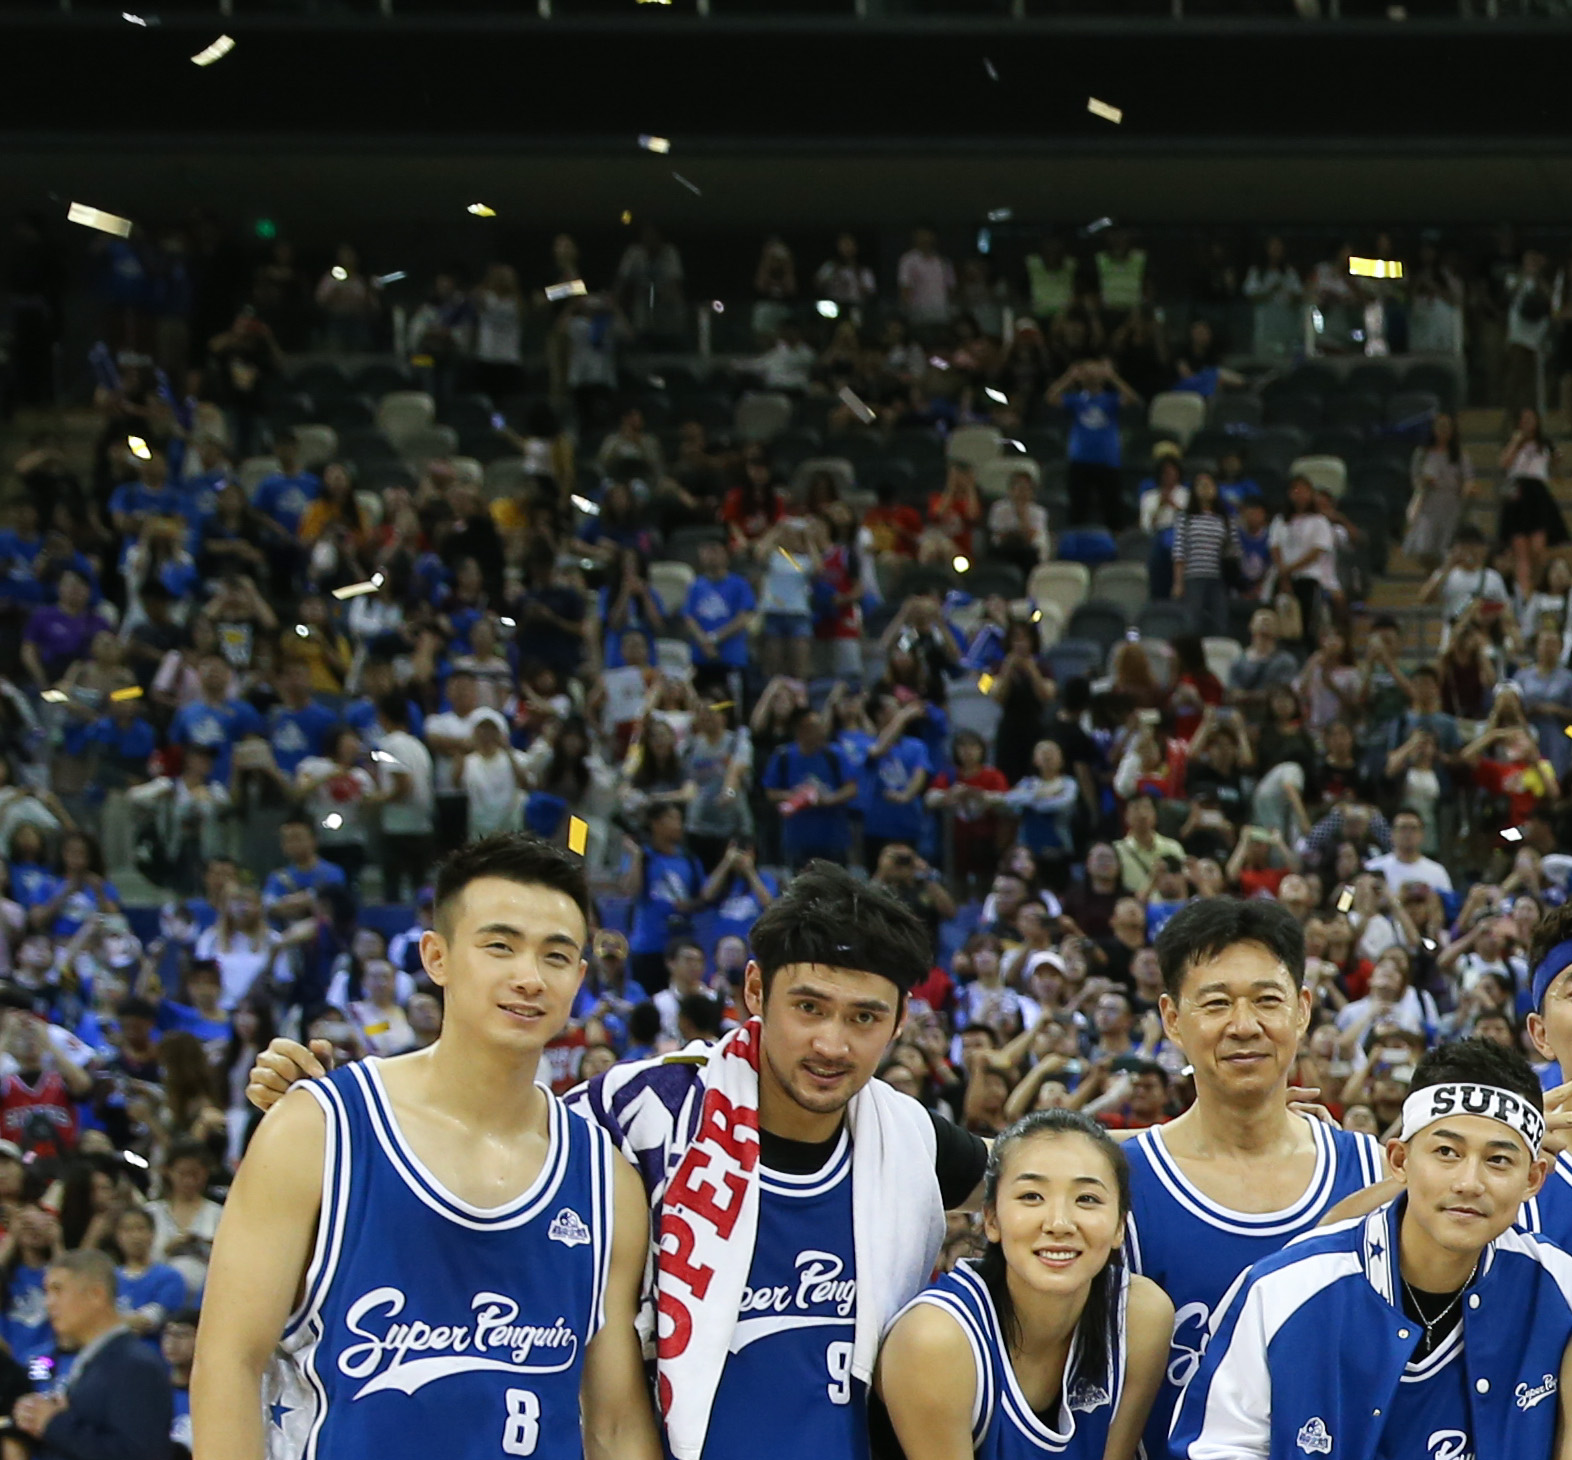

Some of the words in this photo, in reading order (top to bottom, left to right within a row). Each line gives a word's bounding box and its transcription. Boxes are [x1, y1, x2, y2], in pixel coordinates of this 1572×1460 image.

[794, 1250, 857, 1317] Peng
[337, 1286, 472, 1379] Super
[471, 1291, 578, 1364] Penguin
[826, 1340, 855, 1405] 9
[502, 1387, 541, 1458] 8
